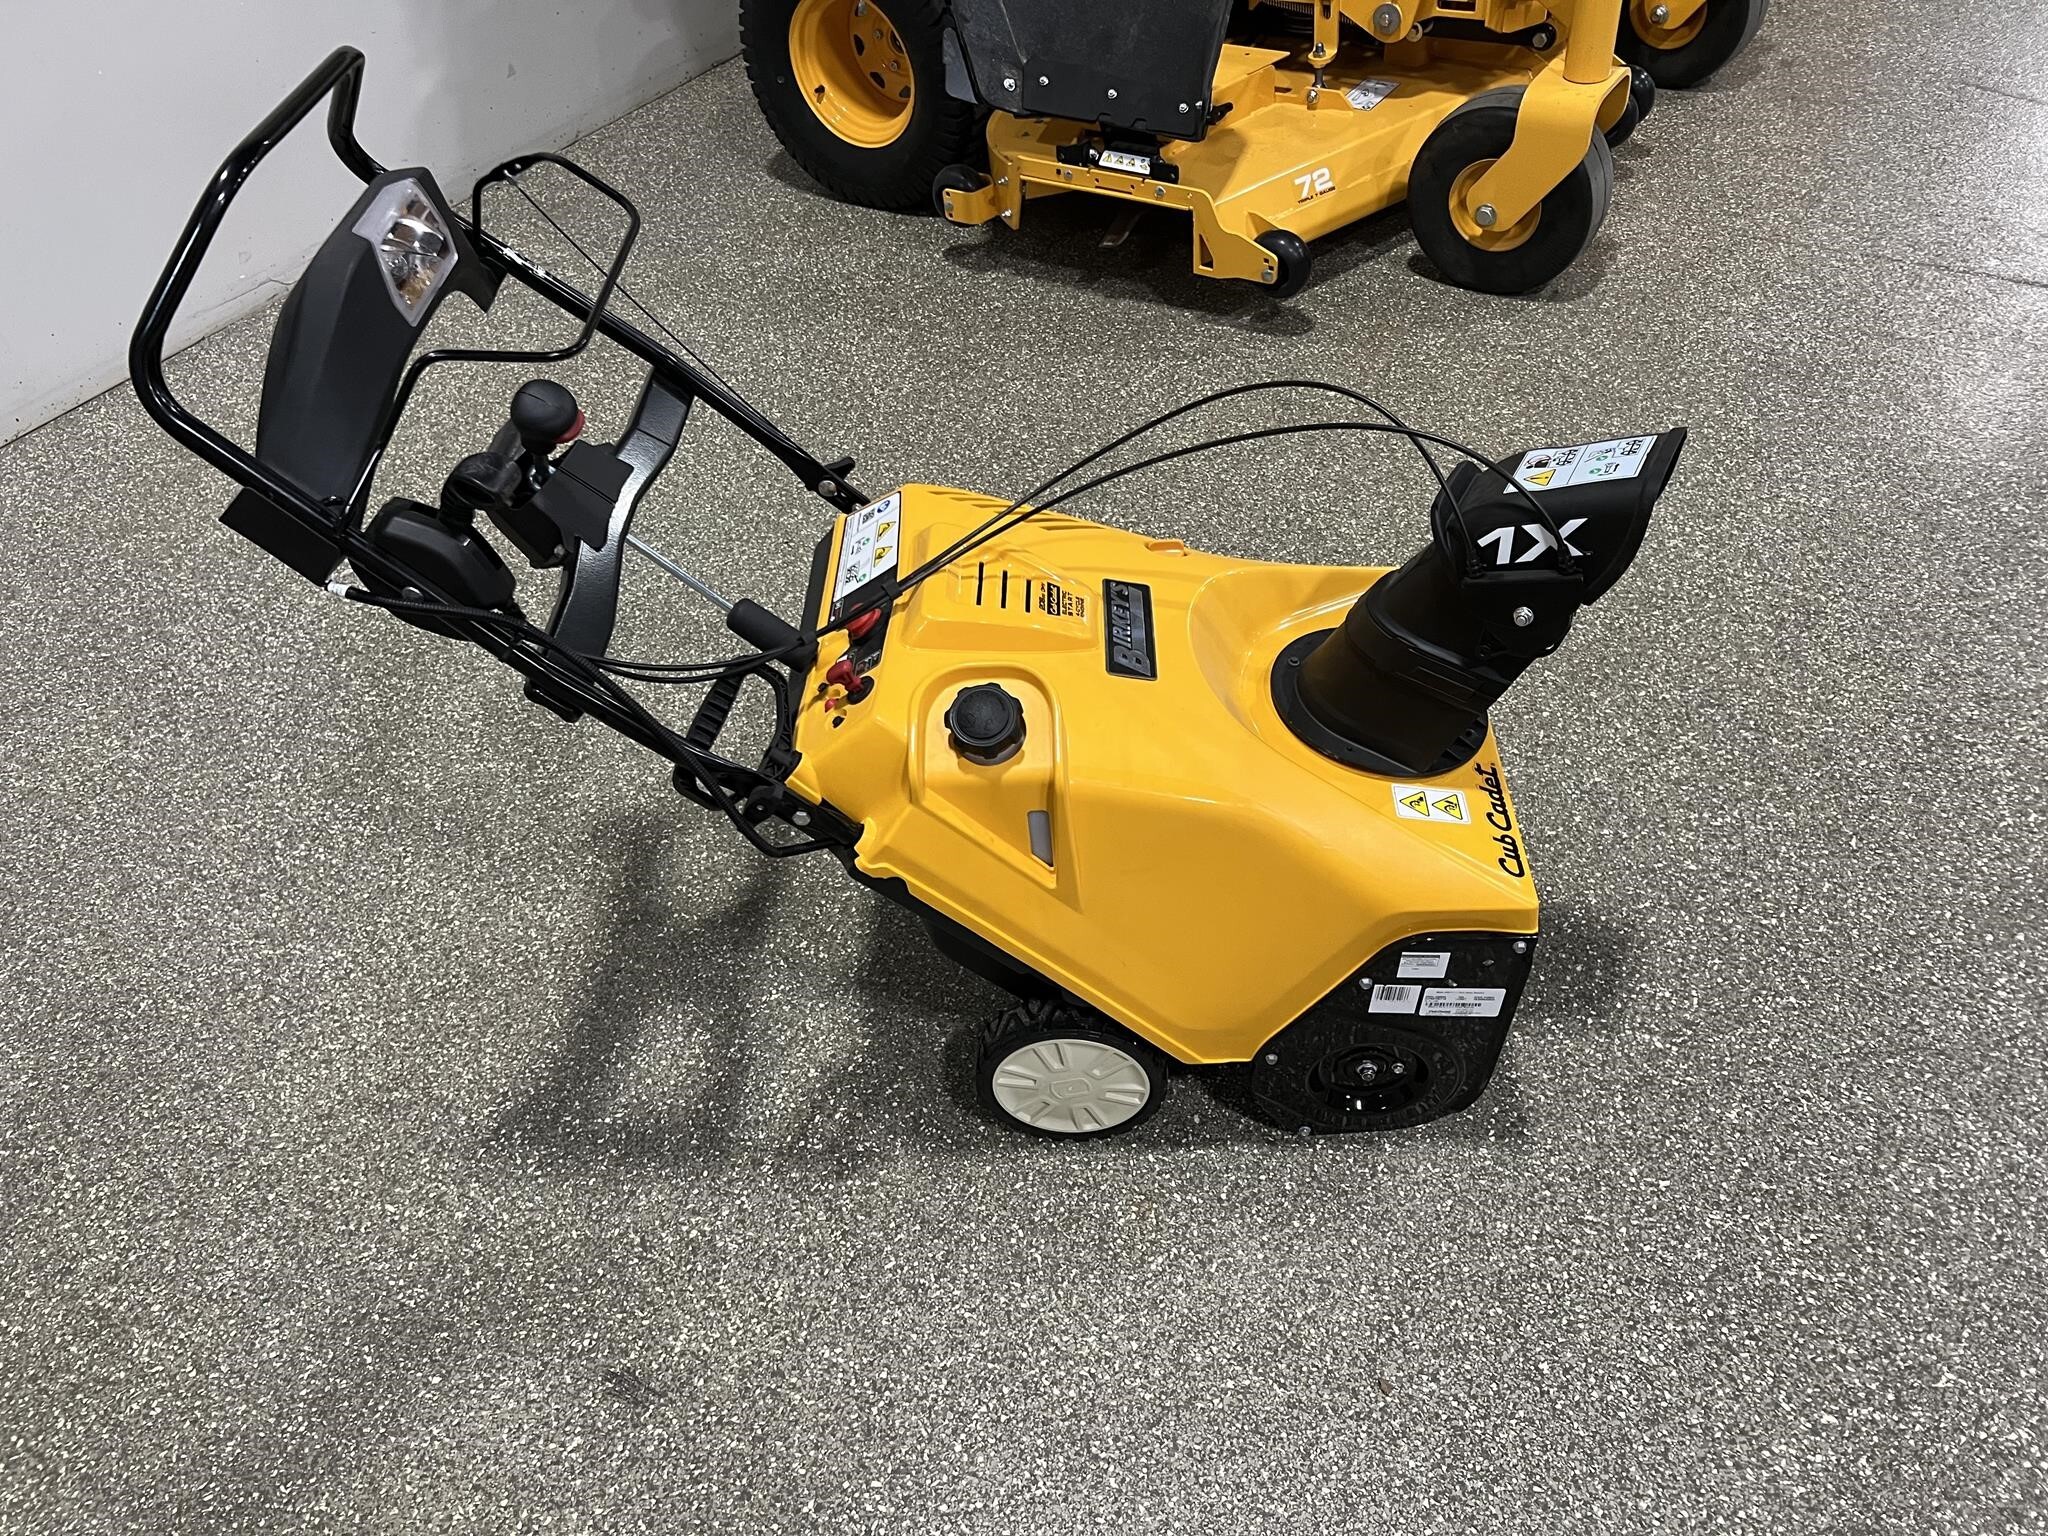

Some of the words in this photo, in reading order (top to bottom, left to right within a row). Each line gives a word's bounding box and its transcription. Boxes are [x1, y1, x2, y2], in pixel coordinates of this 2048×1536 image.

[1294, 167, 1334, 199] 72
[1477, 518, 1588, 565] 1X
[1475, 763, 1512, 832] Cadet
[1493, 834, 1525, 878] Cub
